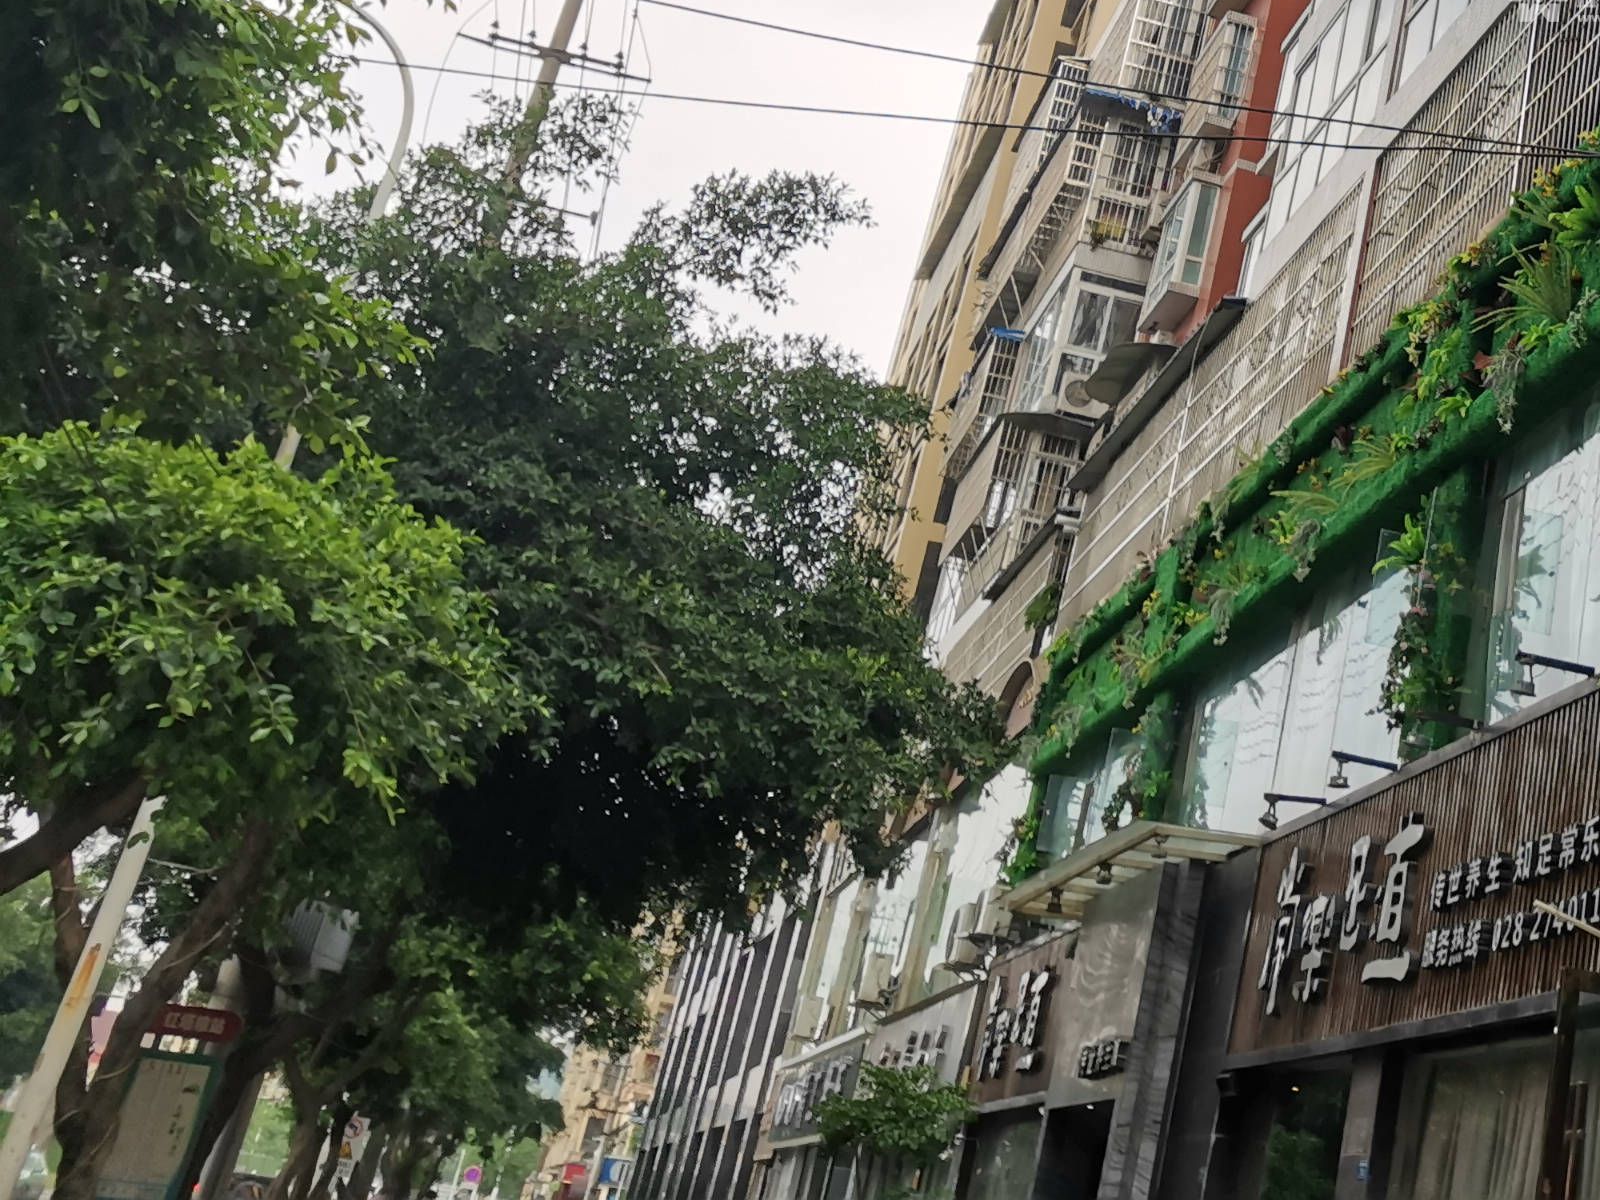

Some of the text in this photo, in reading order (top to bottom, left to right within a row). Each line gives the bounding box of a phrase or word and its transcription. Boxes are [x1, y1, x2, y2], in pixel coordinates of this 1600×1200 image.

[1430, 815, 1600, 912] 传世养生 知足常乐
[1421, 919, 1482, 968] 服务热线
[1491, 913, 1525, 952] 028
